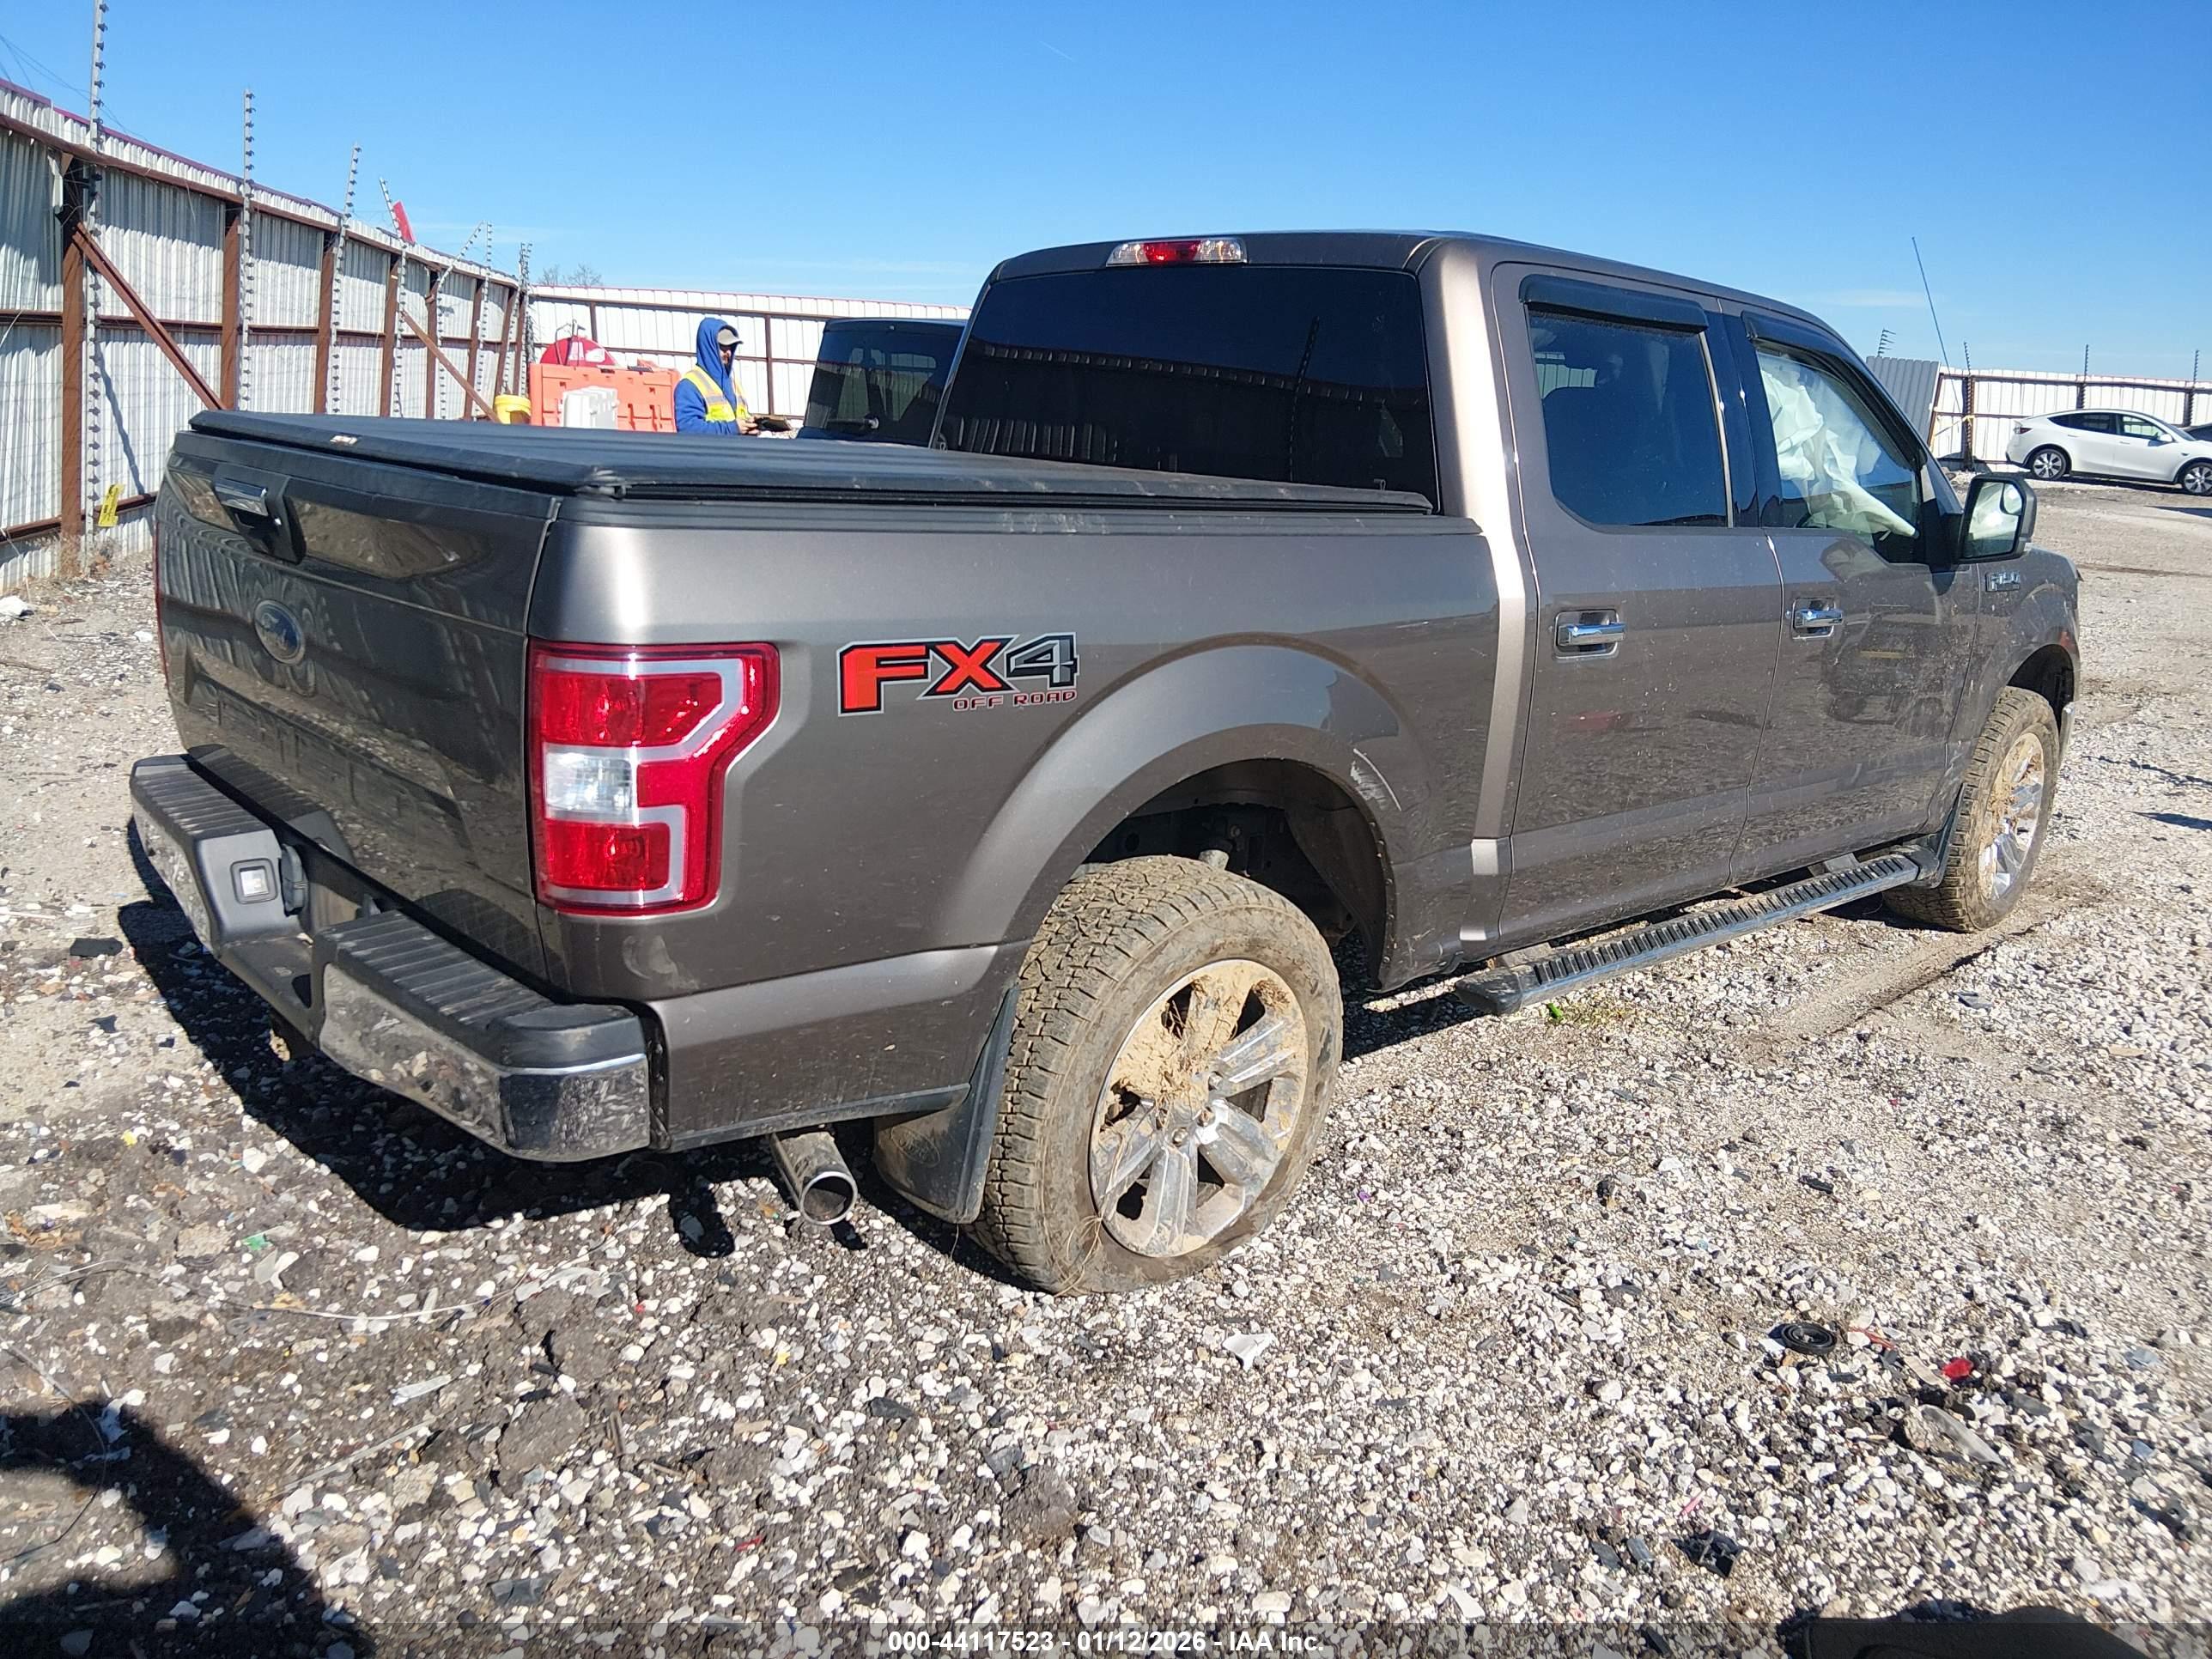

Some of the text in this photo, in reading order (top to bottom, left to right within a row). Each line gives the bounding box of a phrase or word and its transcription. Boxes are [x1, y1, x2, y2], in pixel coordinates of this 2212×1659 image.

[837, 633, 1079, 716] FX4
[952, 690, 1077, 712] OFF ROAD
